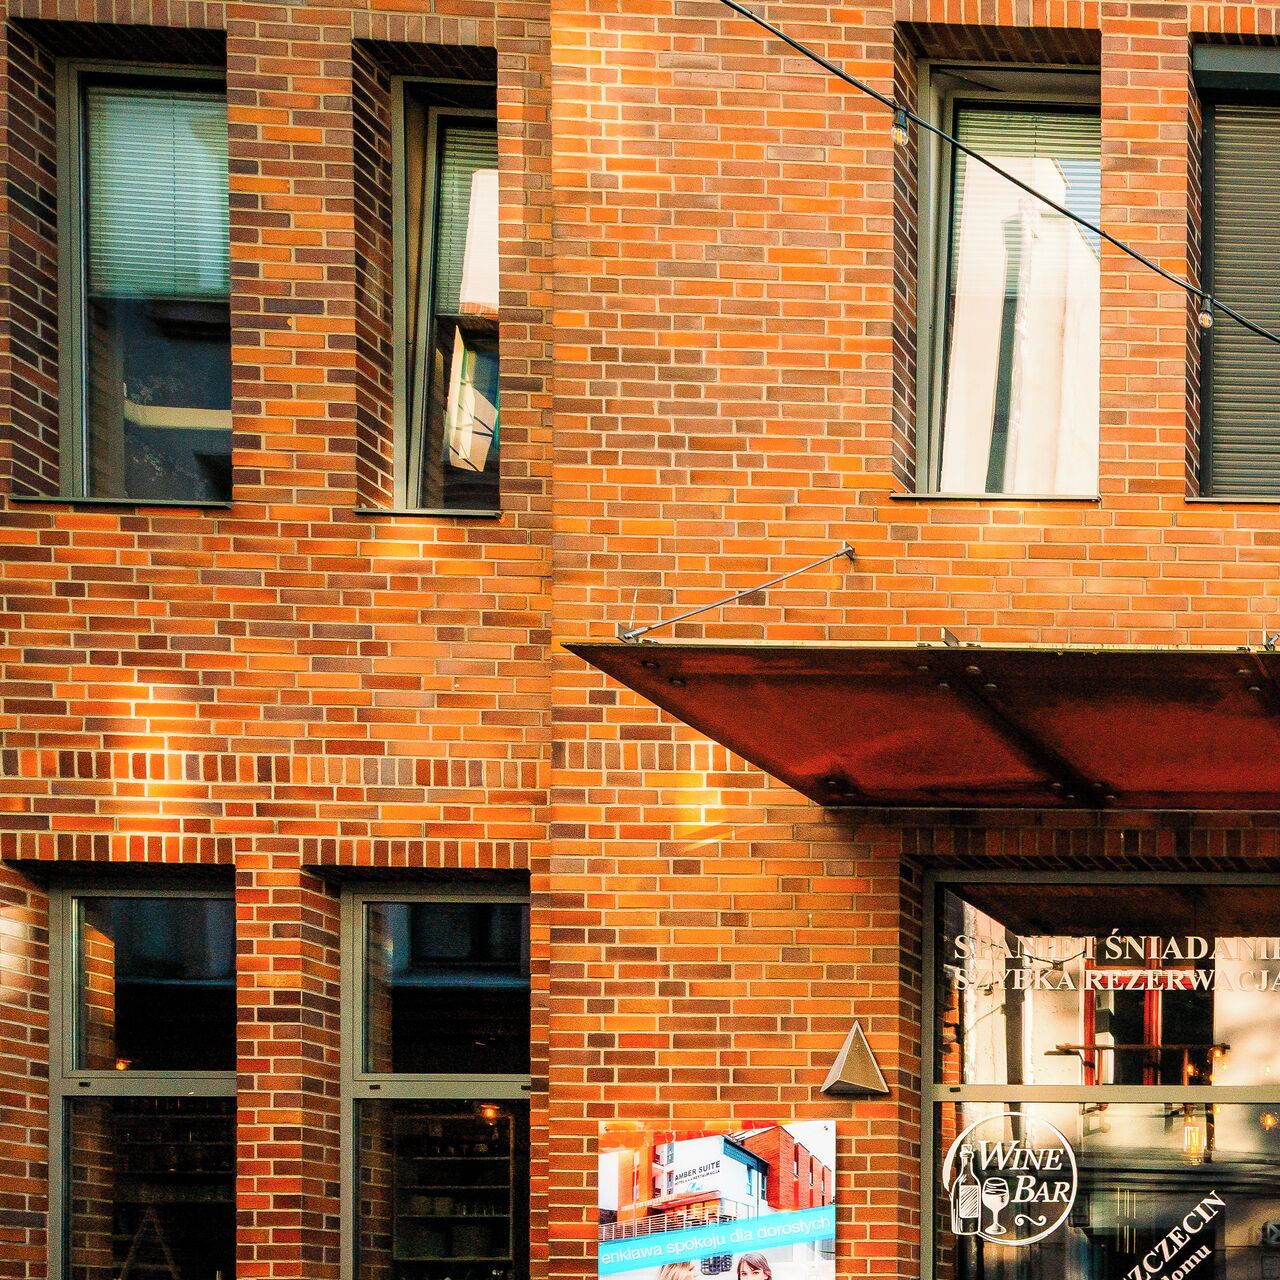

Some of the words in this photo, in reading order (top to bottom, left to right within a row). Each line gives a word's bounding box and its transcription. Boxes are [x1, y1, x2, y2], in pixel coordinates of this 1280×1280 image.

[954, 968, 1077, 991] SZYBKA
[978, 1140, 1064, 1171] WINE
[674, 1167, 697, 1181] AMBER
[698, 1160, 720, 1173] SUITE
[1011, 1175, 1071, 1203] BAR
[602, 1244, 663, 1265] enklawa
[668, 1234, 726, 1256] spokoju
[730, 1228, 754, 1243] dla
[756, 1216, 831, 1241] dorosłych
